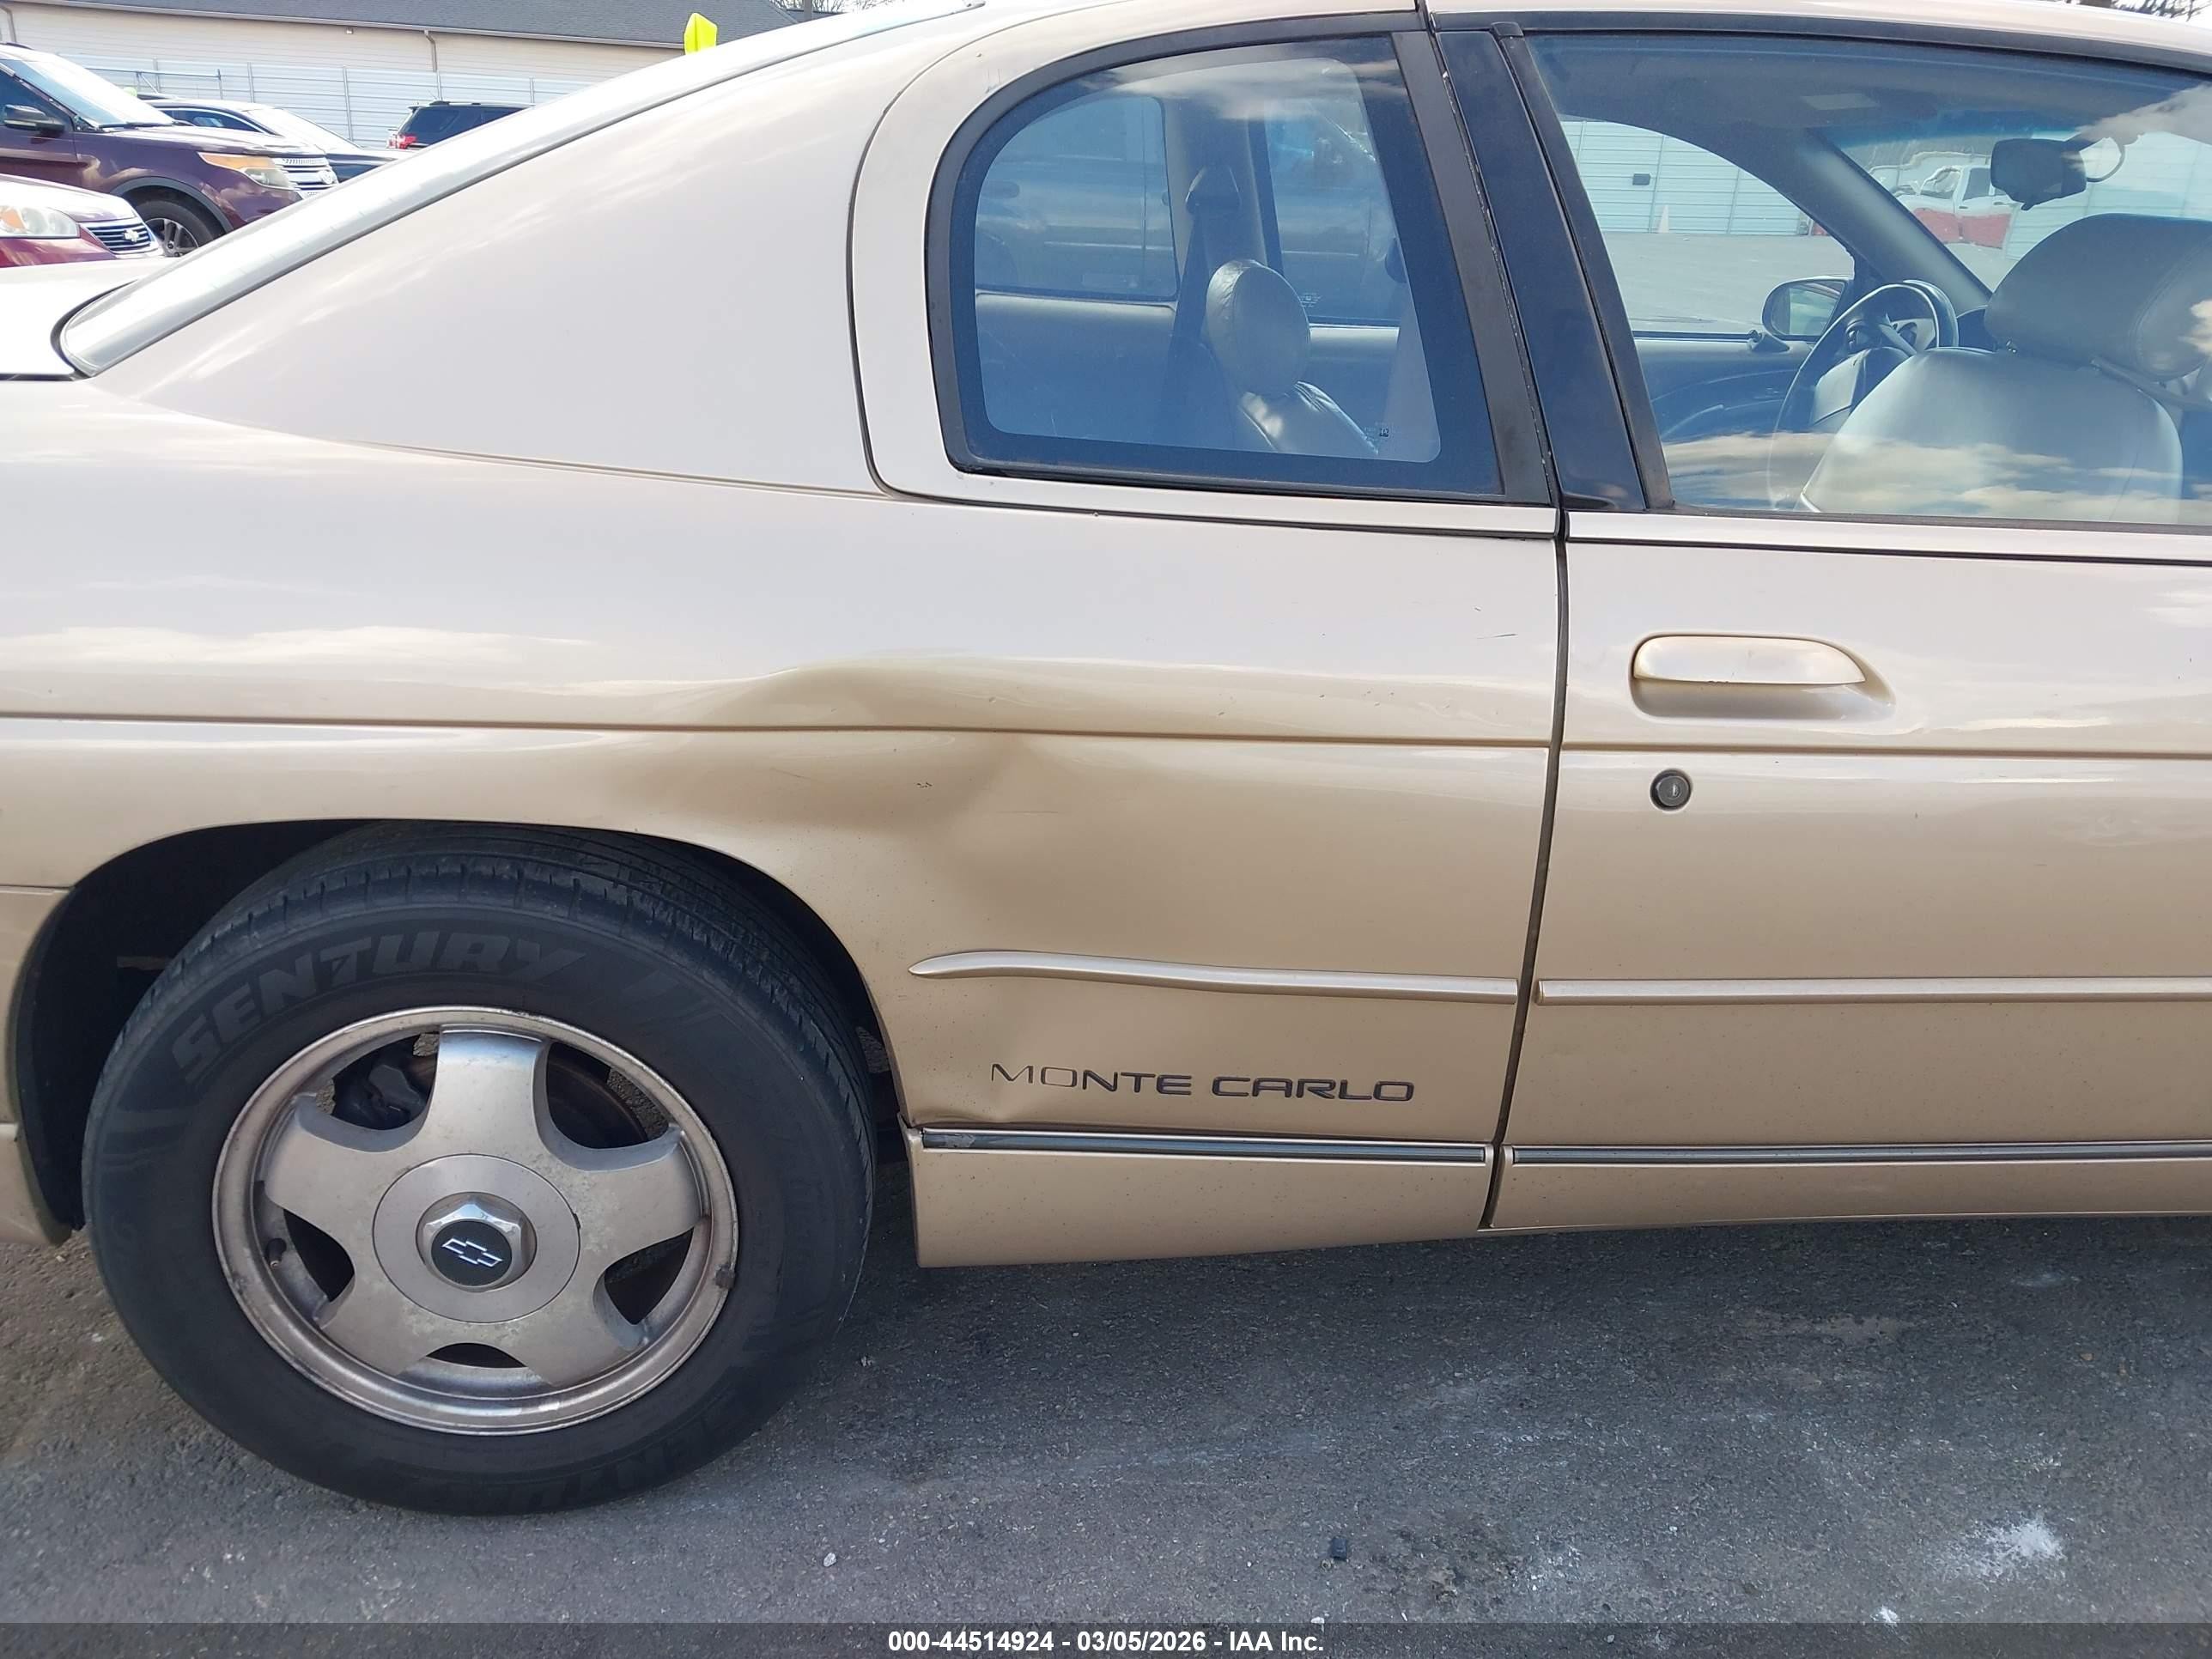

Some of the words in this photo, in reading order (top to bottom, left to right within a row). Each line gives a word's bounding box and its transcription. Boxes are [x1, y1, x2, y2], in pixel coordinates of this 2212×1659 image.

[171, 930, 588, 1086] SENTURY
[990, 1062, 1193, 1096] MONTE
[1212, 1075, 1415, 1102] CARLO
